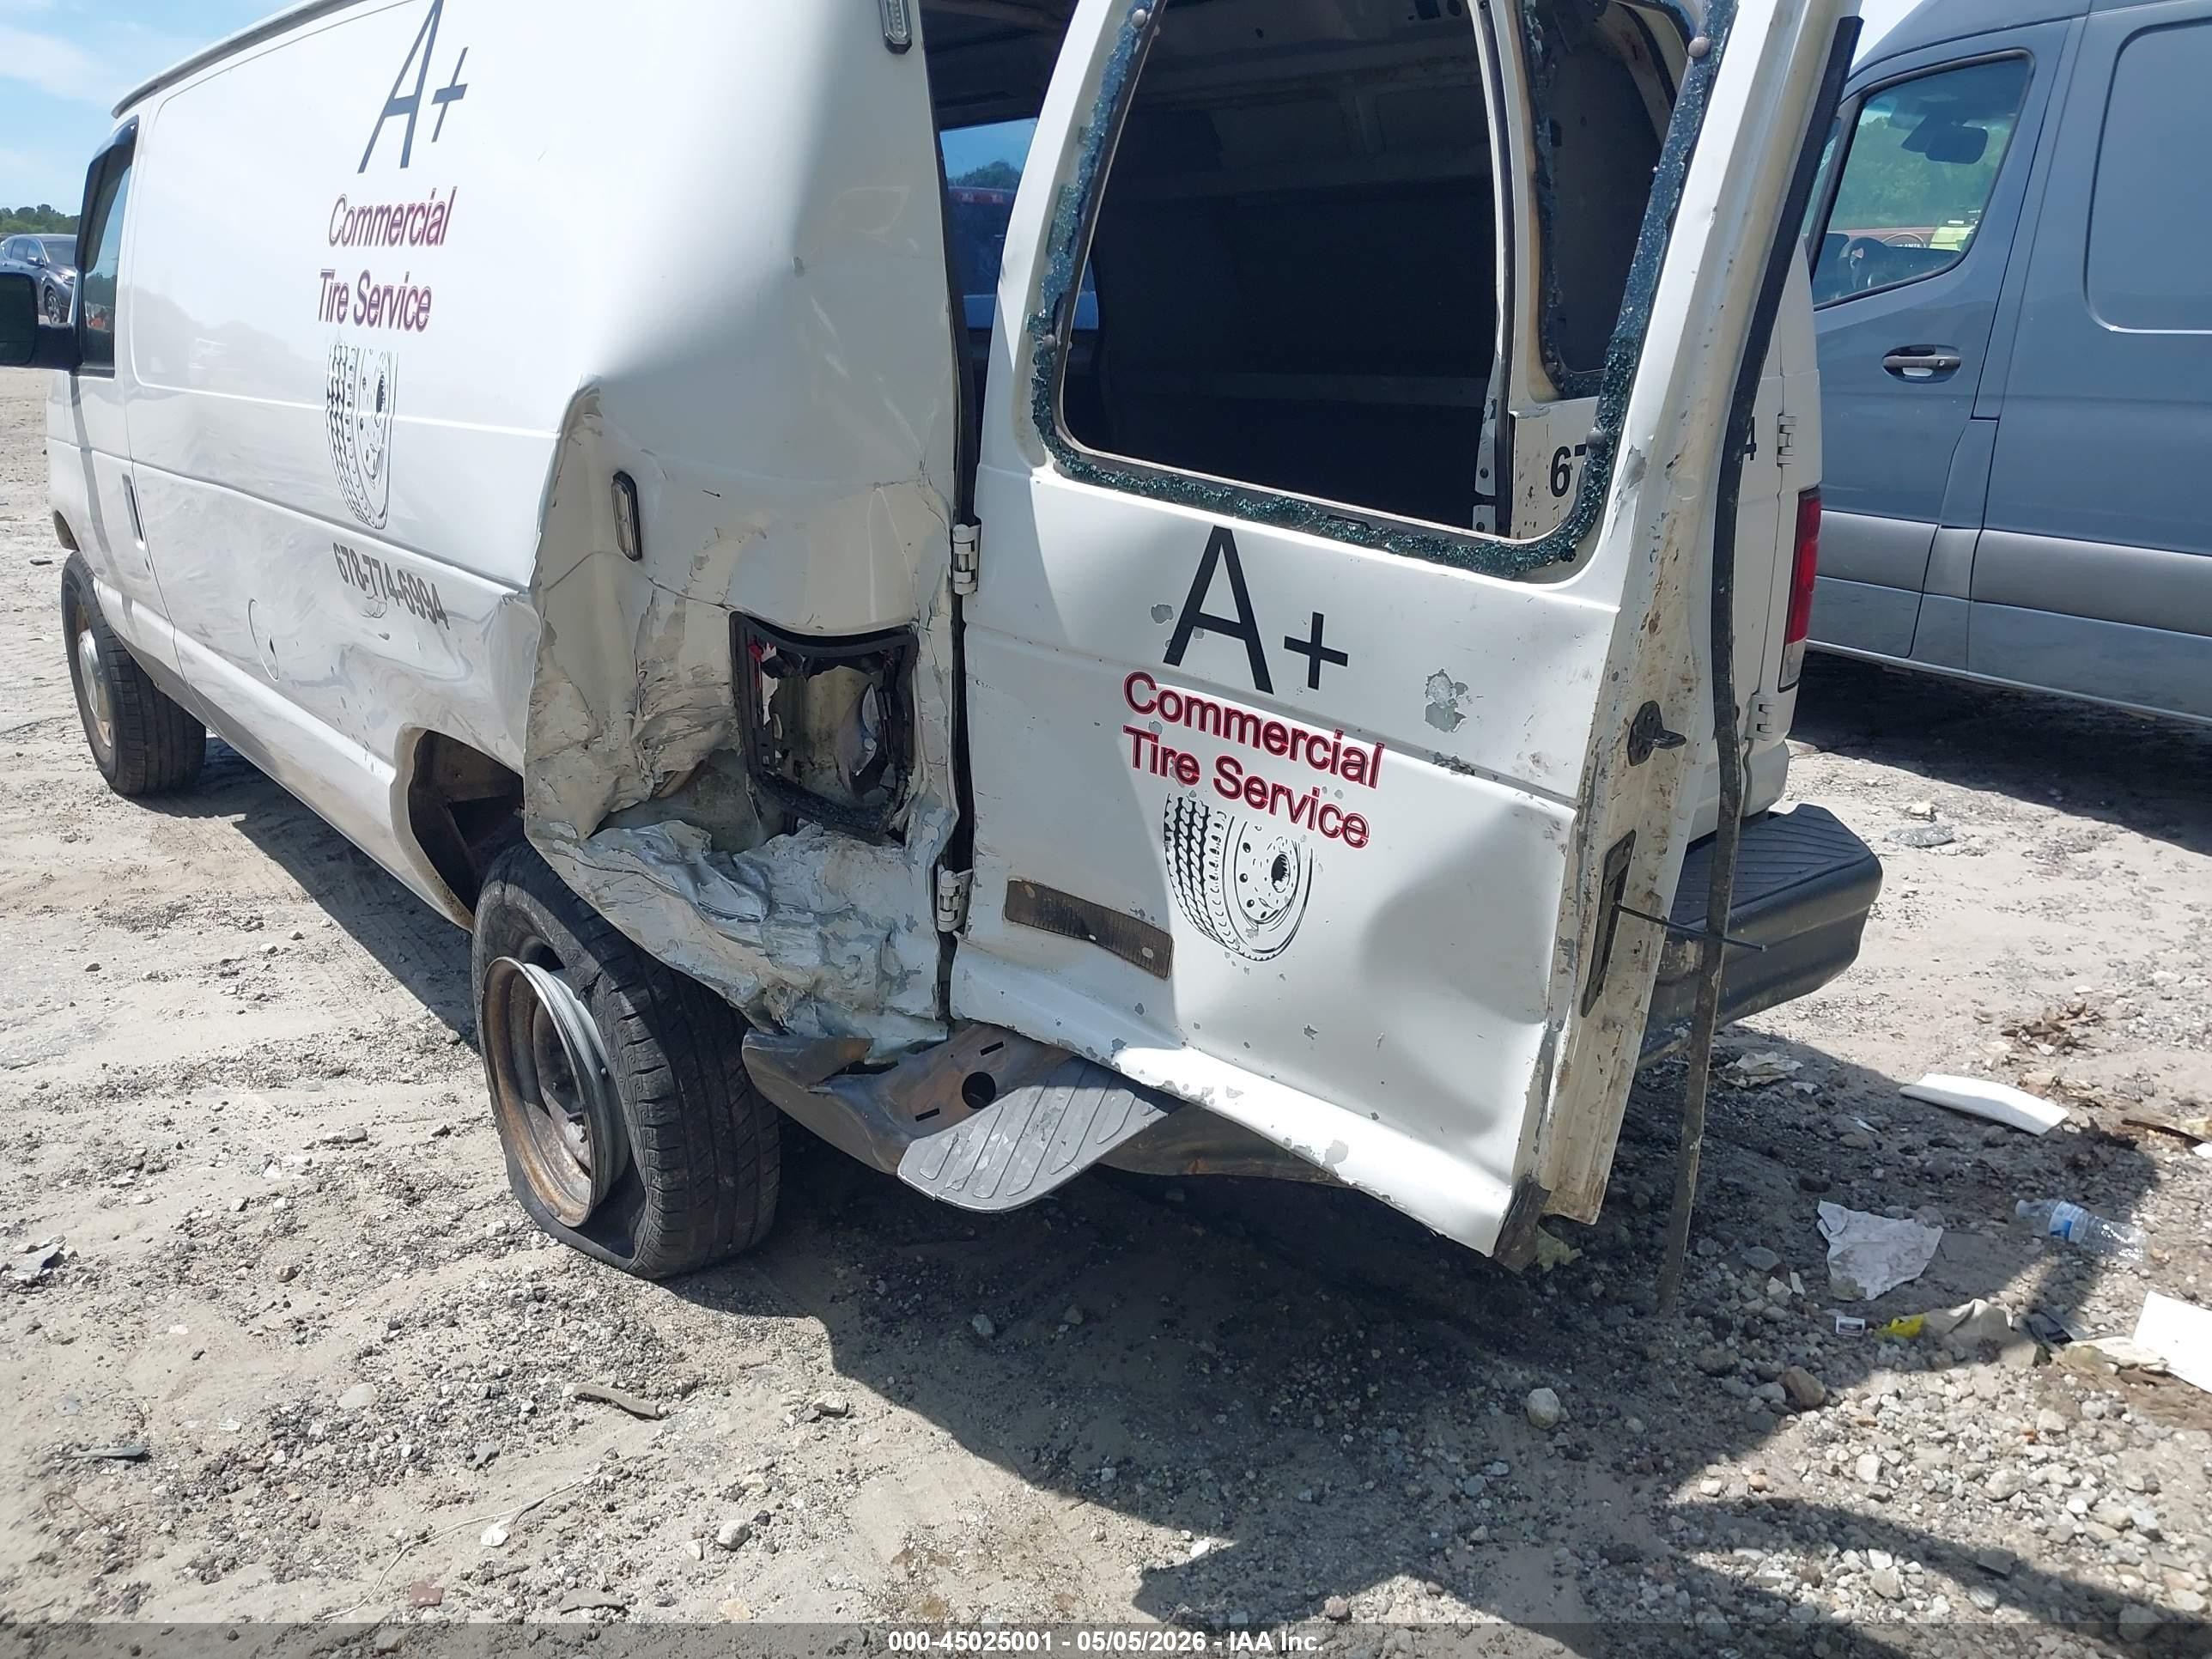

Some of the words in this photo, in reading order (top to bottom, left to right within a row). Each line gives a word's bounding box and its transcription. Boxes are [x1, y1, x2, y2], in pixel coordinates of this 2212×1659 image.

[356, 0, 469, 173] A+
[328, 185, 458, 247] Commercial
[318, 268, 349, 324] Tire
[353, 269, 432, 332] Service
[332, 542, 450, 631] 678-774-6994
[1163, 525, 1348, 696] A+
[1121, 725, 1202, 787] Tire
[1212, 755, 1371, 850] Service
[1122, 671, 1385, 790] Commercial
